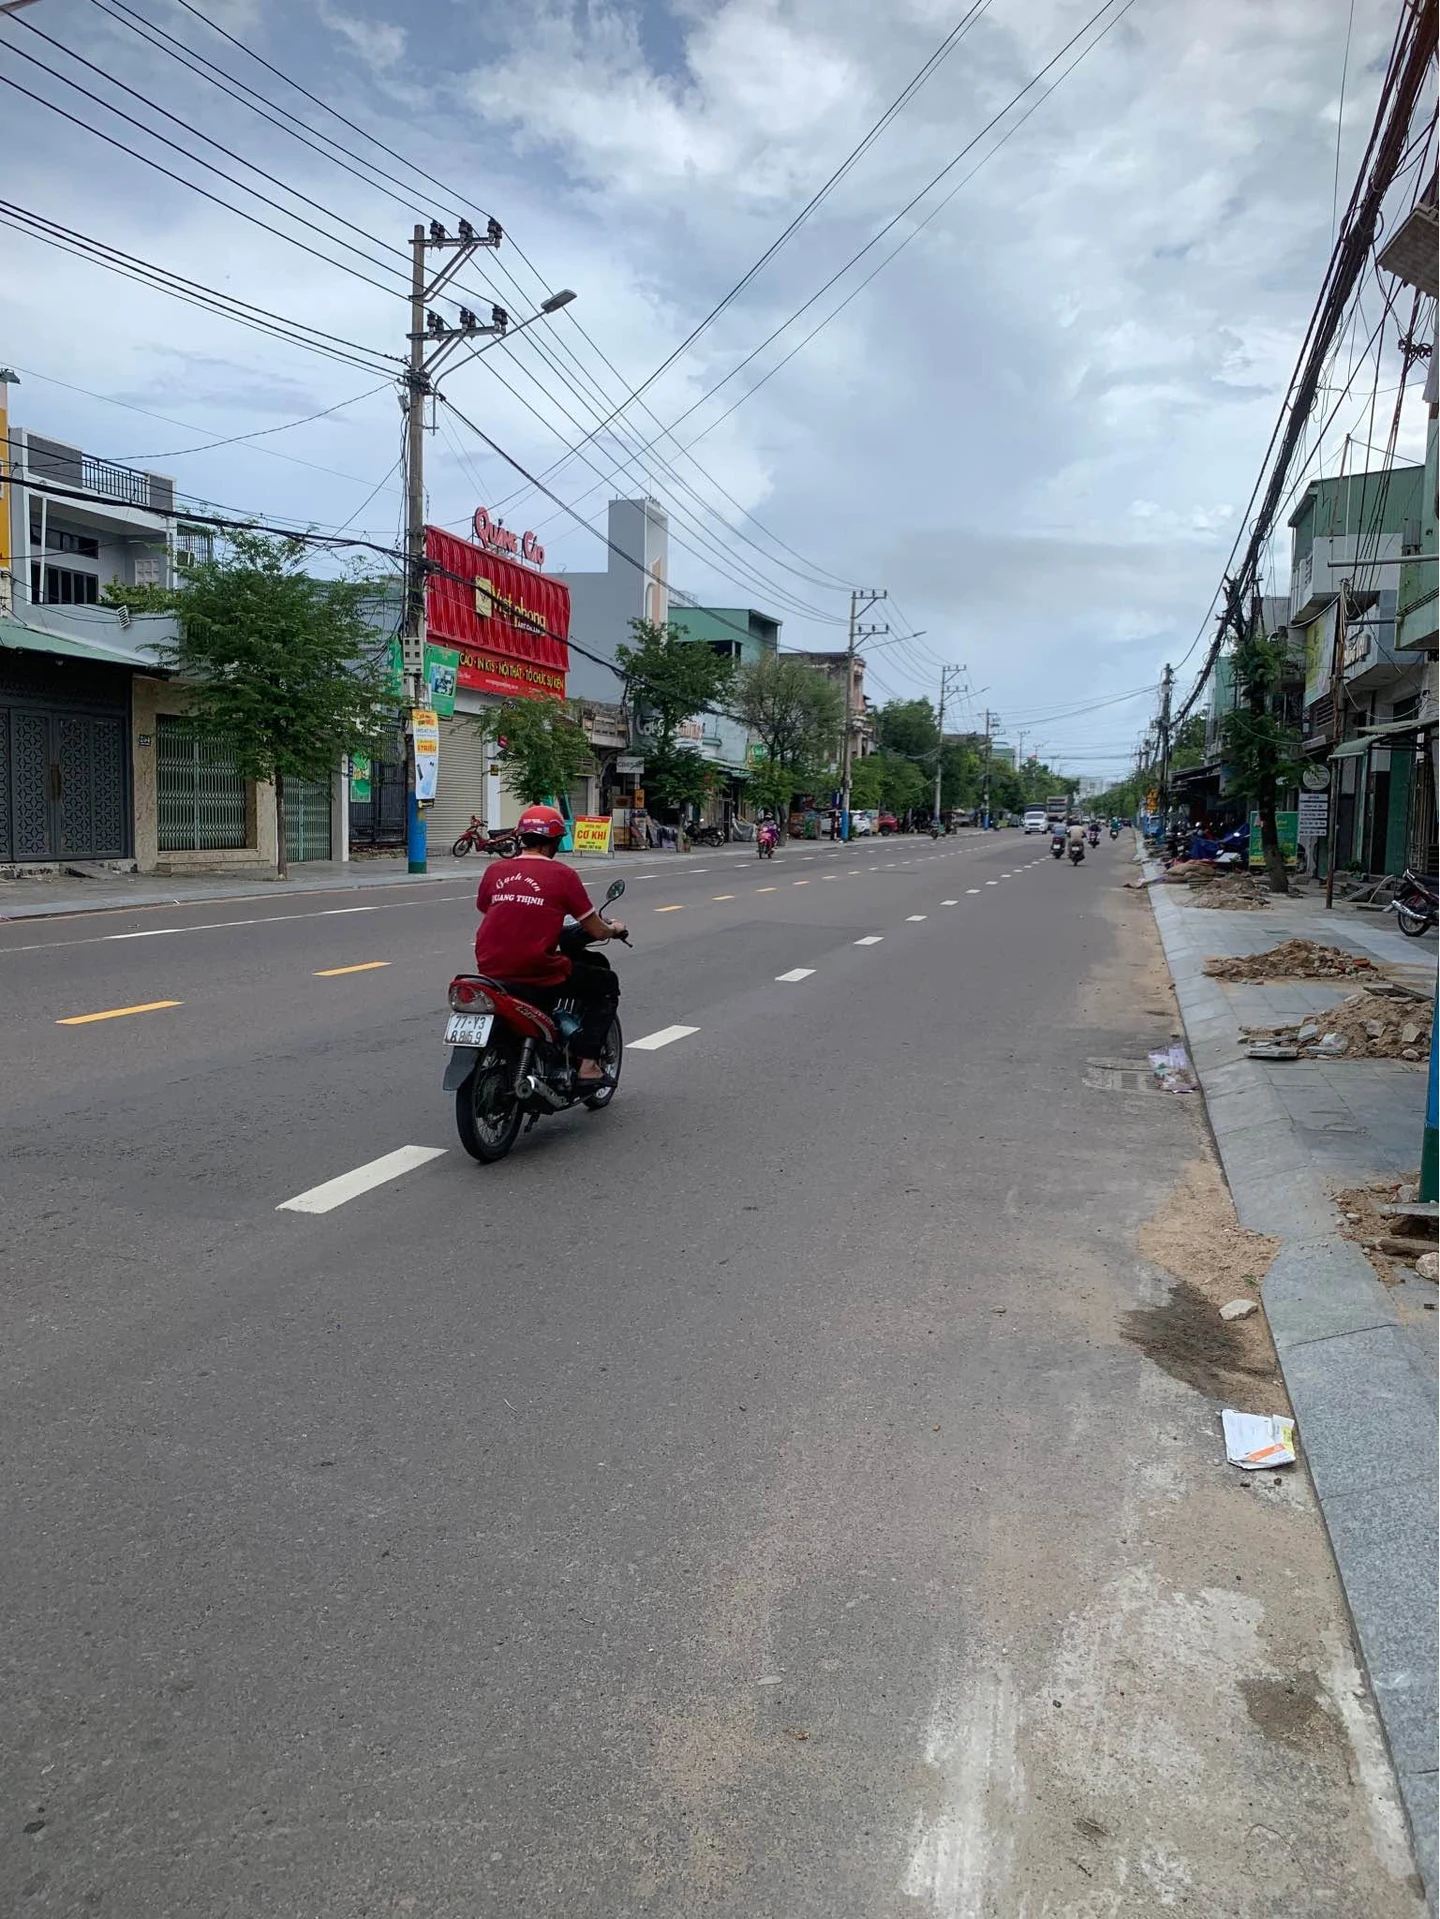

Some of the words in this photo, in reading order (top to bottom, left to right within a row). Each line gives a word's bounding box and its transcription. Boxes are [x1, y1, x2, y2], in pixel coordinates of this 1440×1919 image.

[577, 829, 590, 840] CƠ
[591, 829, 607, 841] KHÍ
[516, 894, 544, 906] THỊNH
